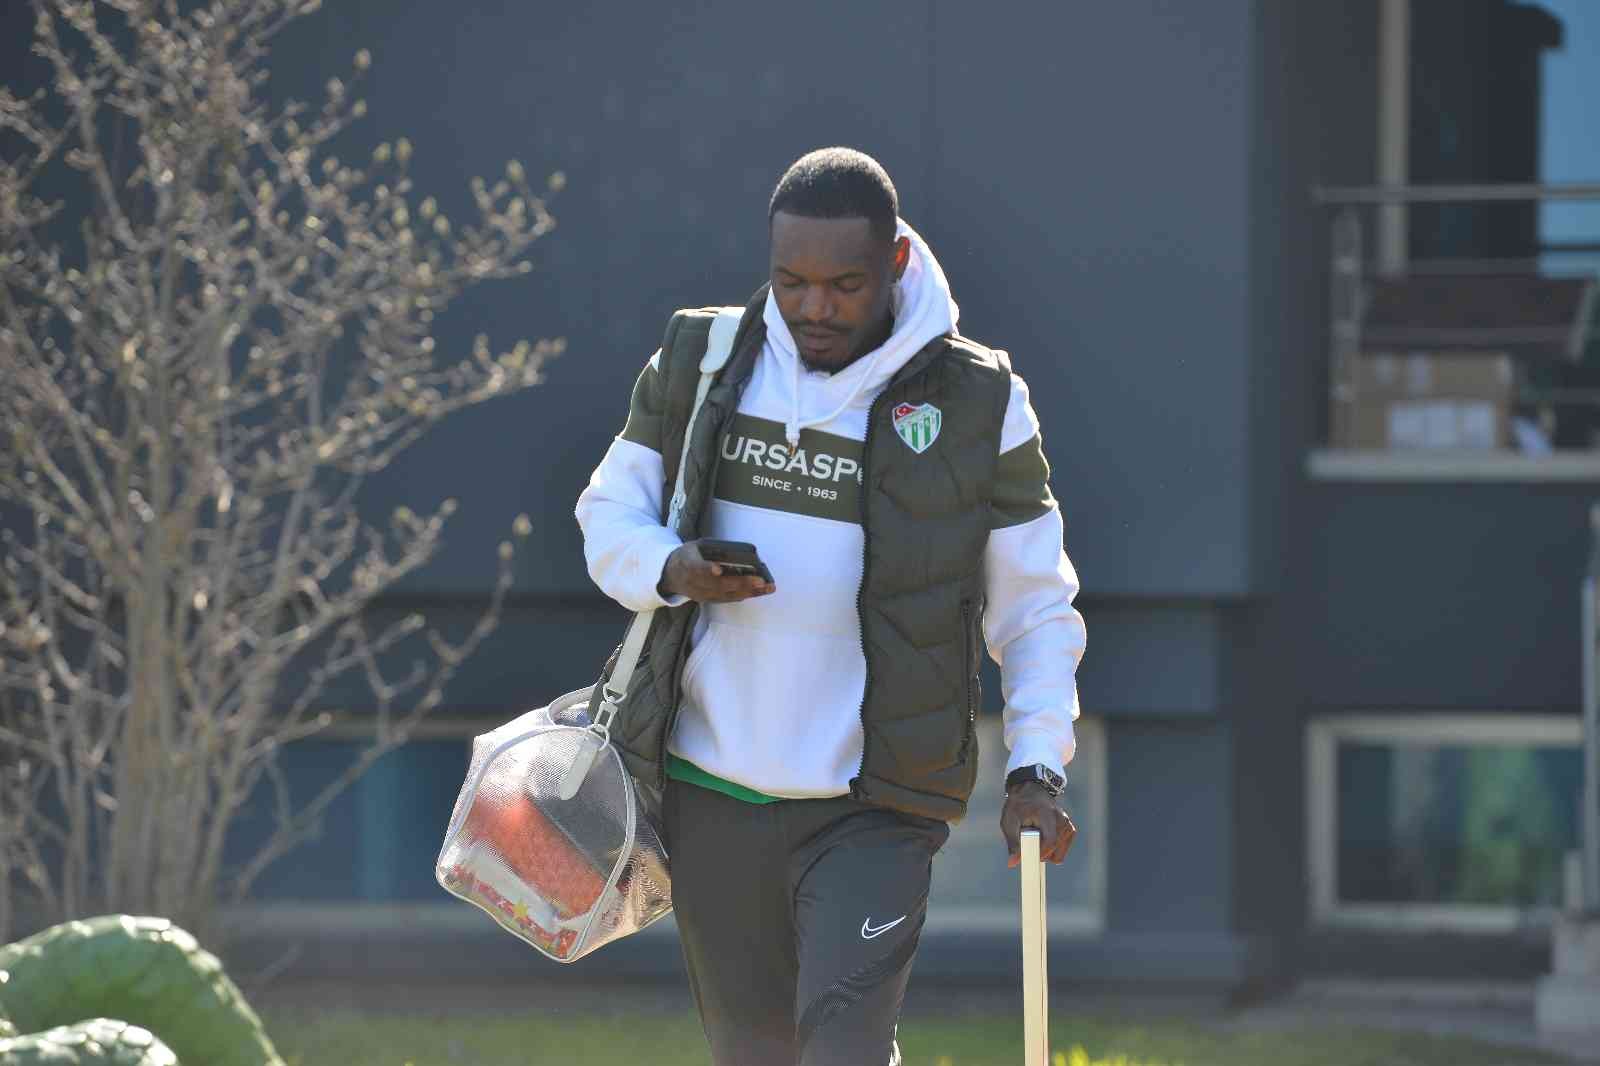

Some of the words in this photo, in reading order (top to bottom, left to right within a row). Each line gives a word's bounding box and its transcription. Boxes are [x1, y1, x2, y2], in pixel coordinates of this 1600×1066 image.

[721, 434, 863, 483] URSASP
[752, 475, 792, 491] SINCE
[808, 487, 838, 500] 1963
